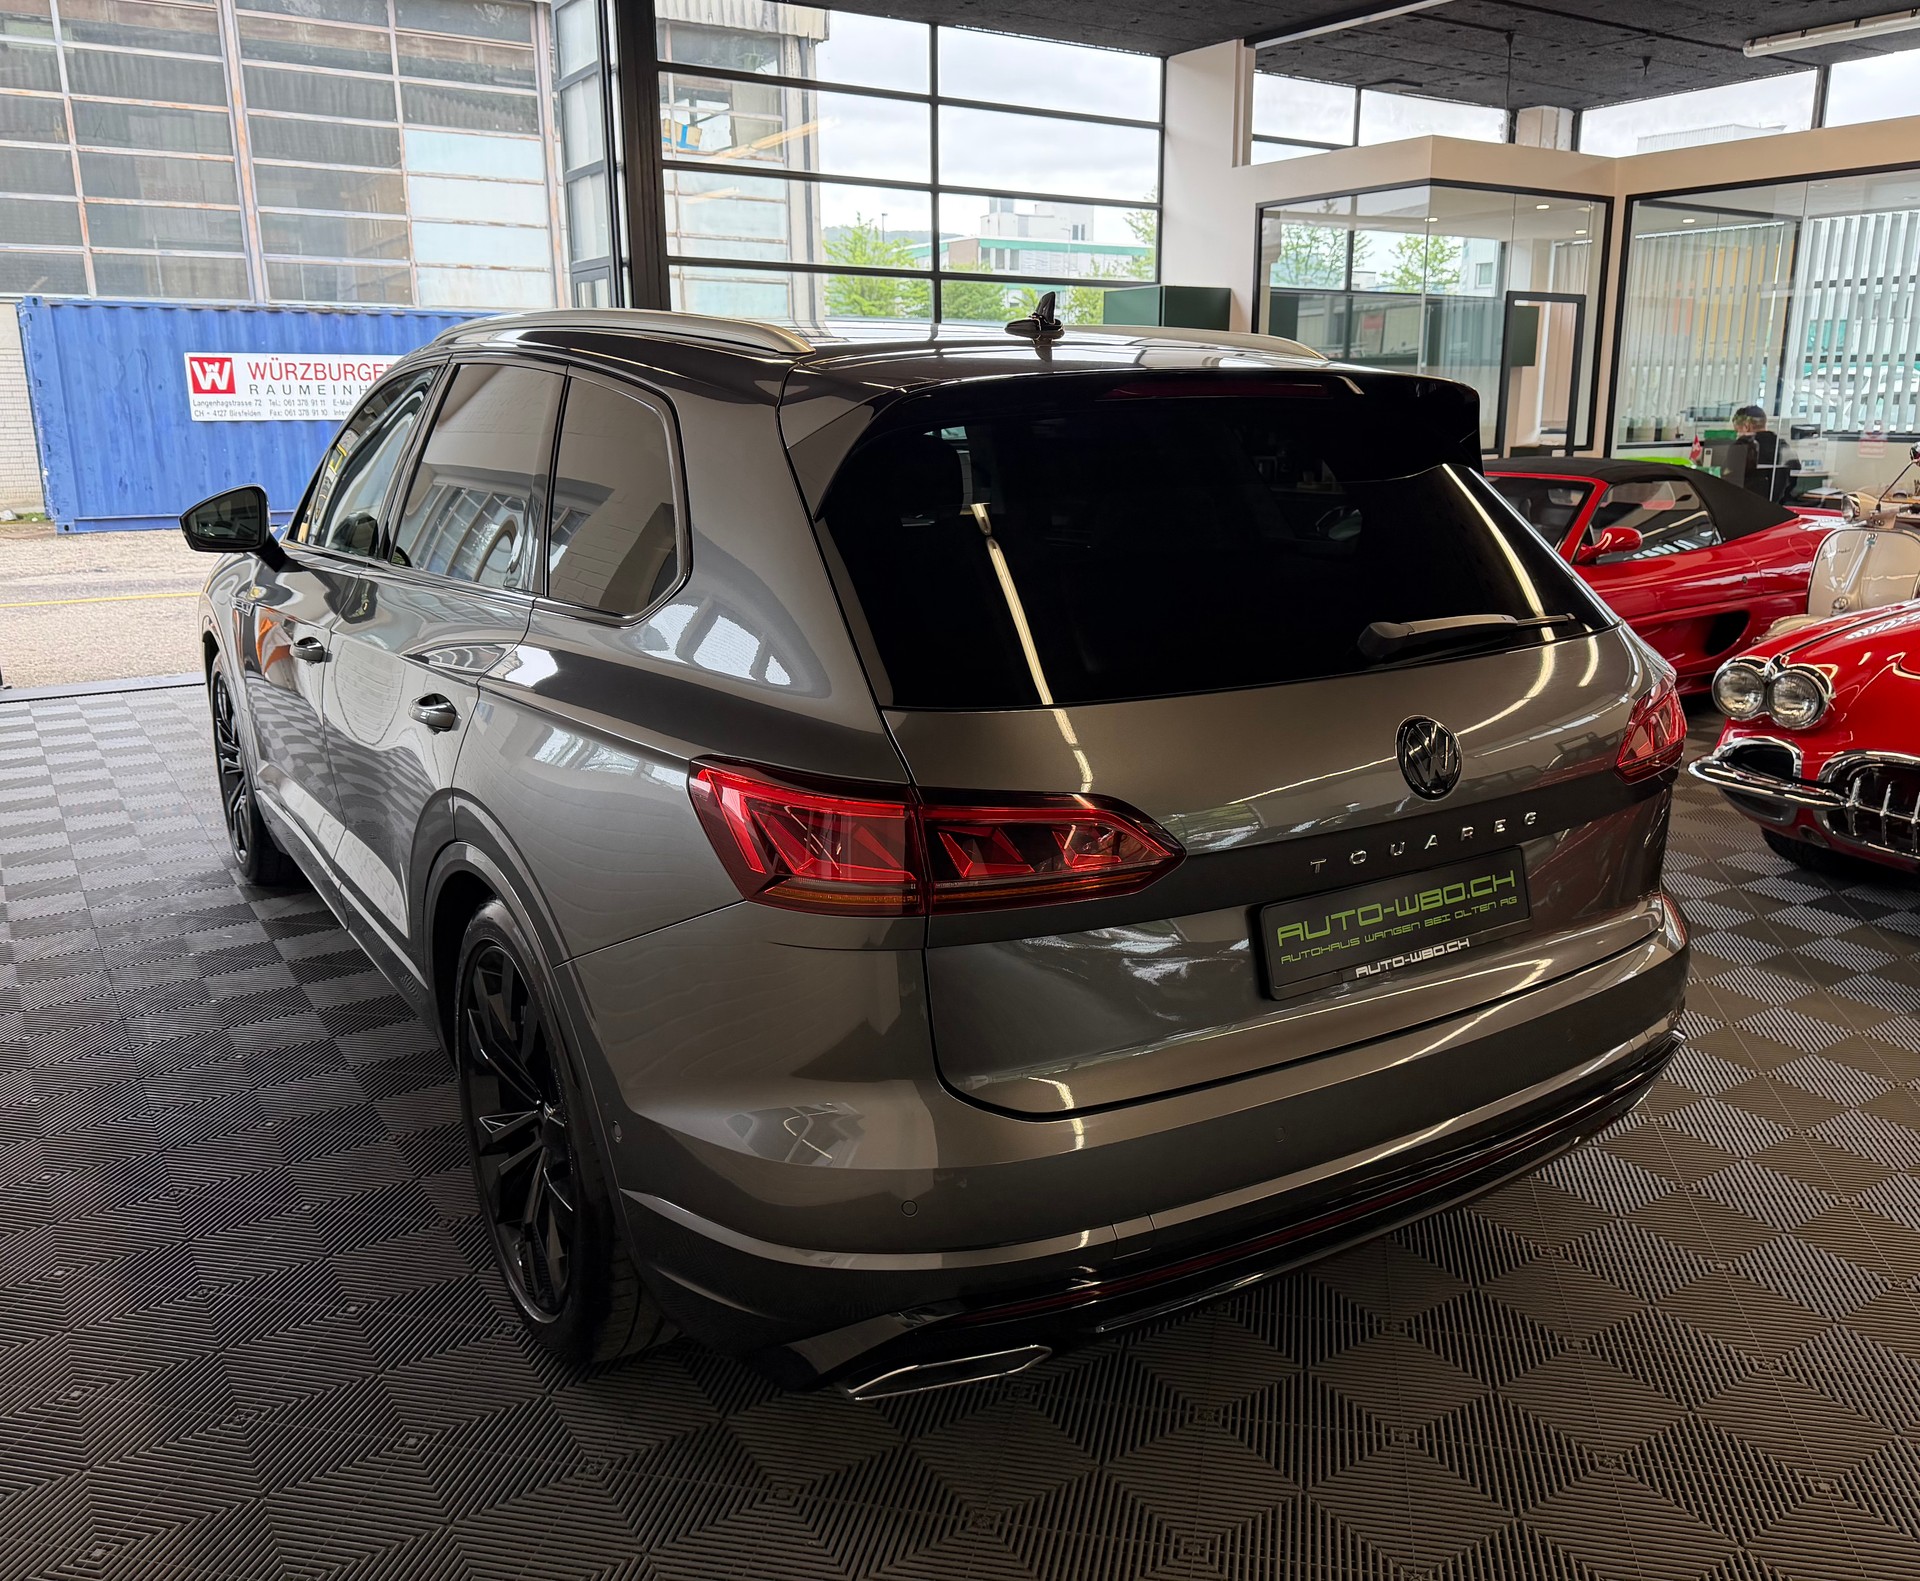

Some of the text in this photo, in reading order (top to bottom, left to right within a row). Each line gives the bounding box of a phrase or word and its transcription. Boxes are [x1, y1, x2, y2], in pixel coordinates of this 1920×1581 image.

[247, 357, 395, 381] WÜRZBURGE
[192, 399, 252, 408] Langenhagstrasse
[254, 399, 262, 407] 72
[283, 399, 295, 407] 061
[311, 399, 318, 407] 91
[319, 399, 326, 407] 11
[194, 409, 204, 417] CH
[213, 409, 227, 417] 4127
[229, 409, 261, 417] Birsfelden
[269, 409, 282, 417] Fax:
[284, 409, 296, 417] 061
[312, 409, 319, 417] 91
[321, 409, 328, 417] 10
[1310, 811, 1537, 874] TOUAREG
[1277, 869, 1516, 947] AUTO-WBO.CH
[1280, 895, 1518, 965] AUTOHAUS WANGEN BEI OLTEN AG
[1355, 937, 1470, 978] AUTO-WBO.CH
